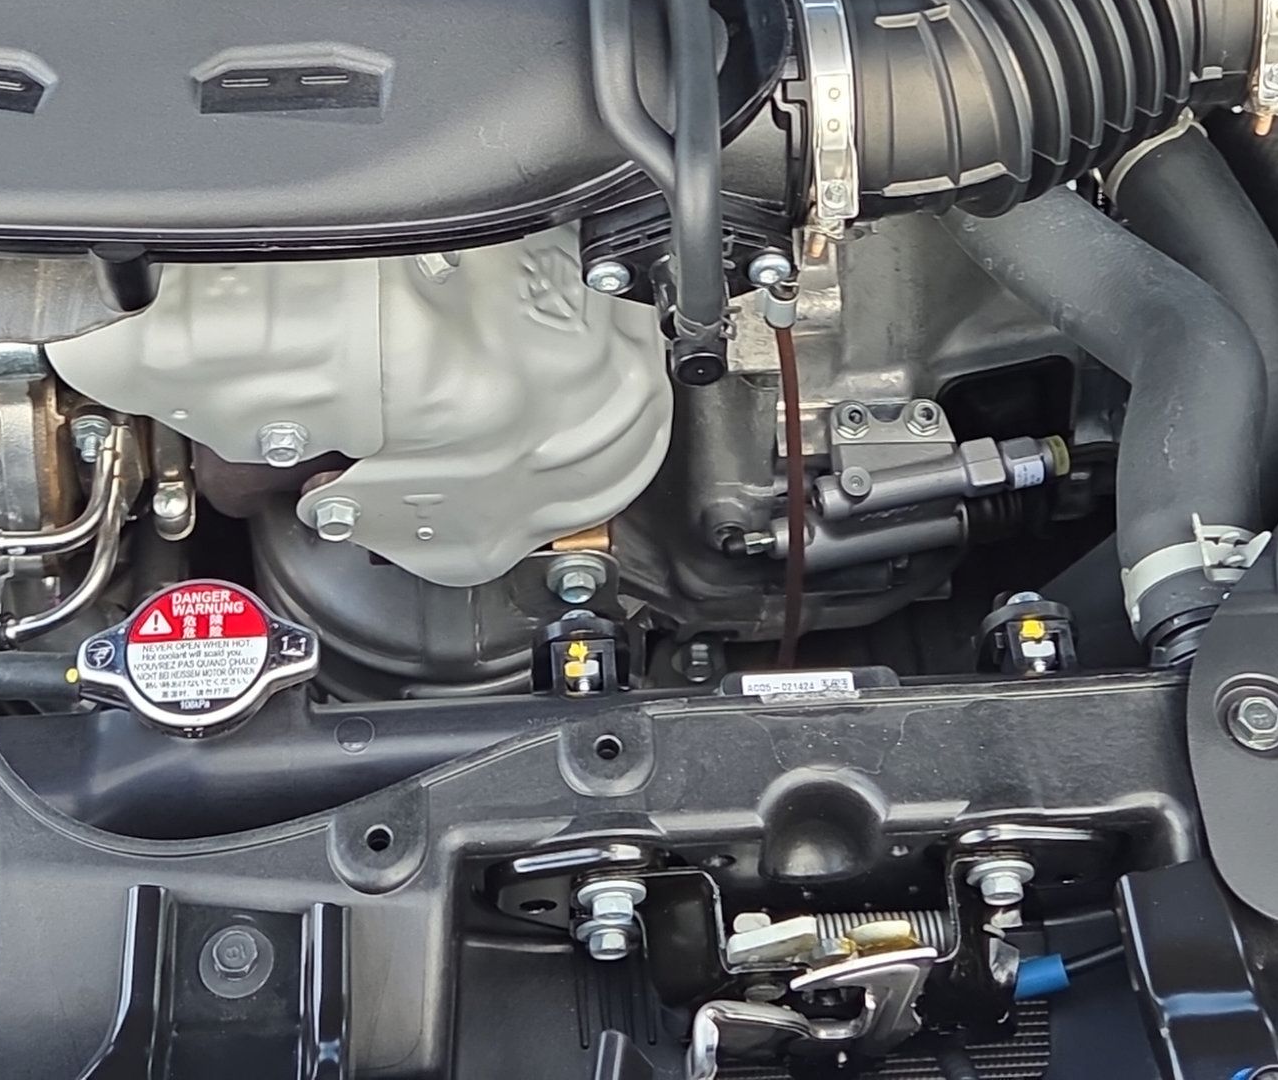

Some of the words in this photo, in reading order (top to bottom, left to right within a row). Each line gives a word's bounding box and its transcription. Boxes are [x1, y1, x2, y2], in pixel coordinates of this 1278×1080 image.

[172, 589, 231, 605] DANGER
[172, 601, 245, 617] WARNUNG
[141, 643, 173, 653] NEVER
[175, 641, 203, 651] OPEN
[203, 640, 230, 650] WHEN
[231, 639, 253, 648] HOT.
[178, 659, 195, 669] PAS
[196, 658, 227, 668] QUAND
[202, 668, 227, 677] MOTOR
